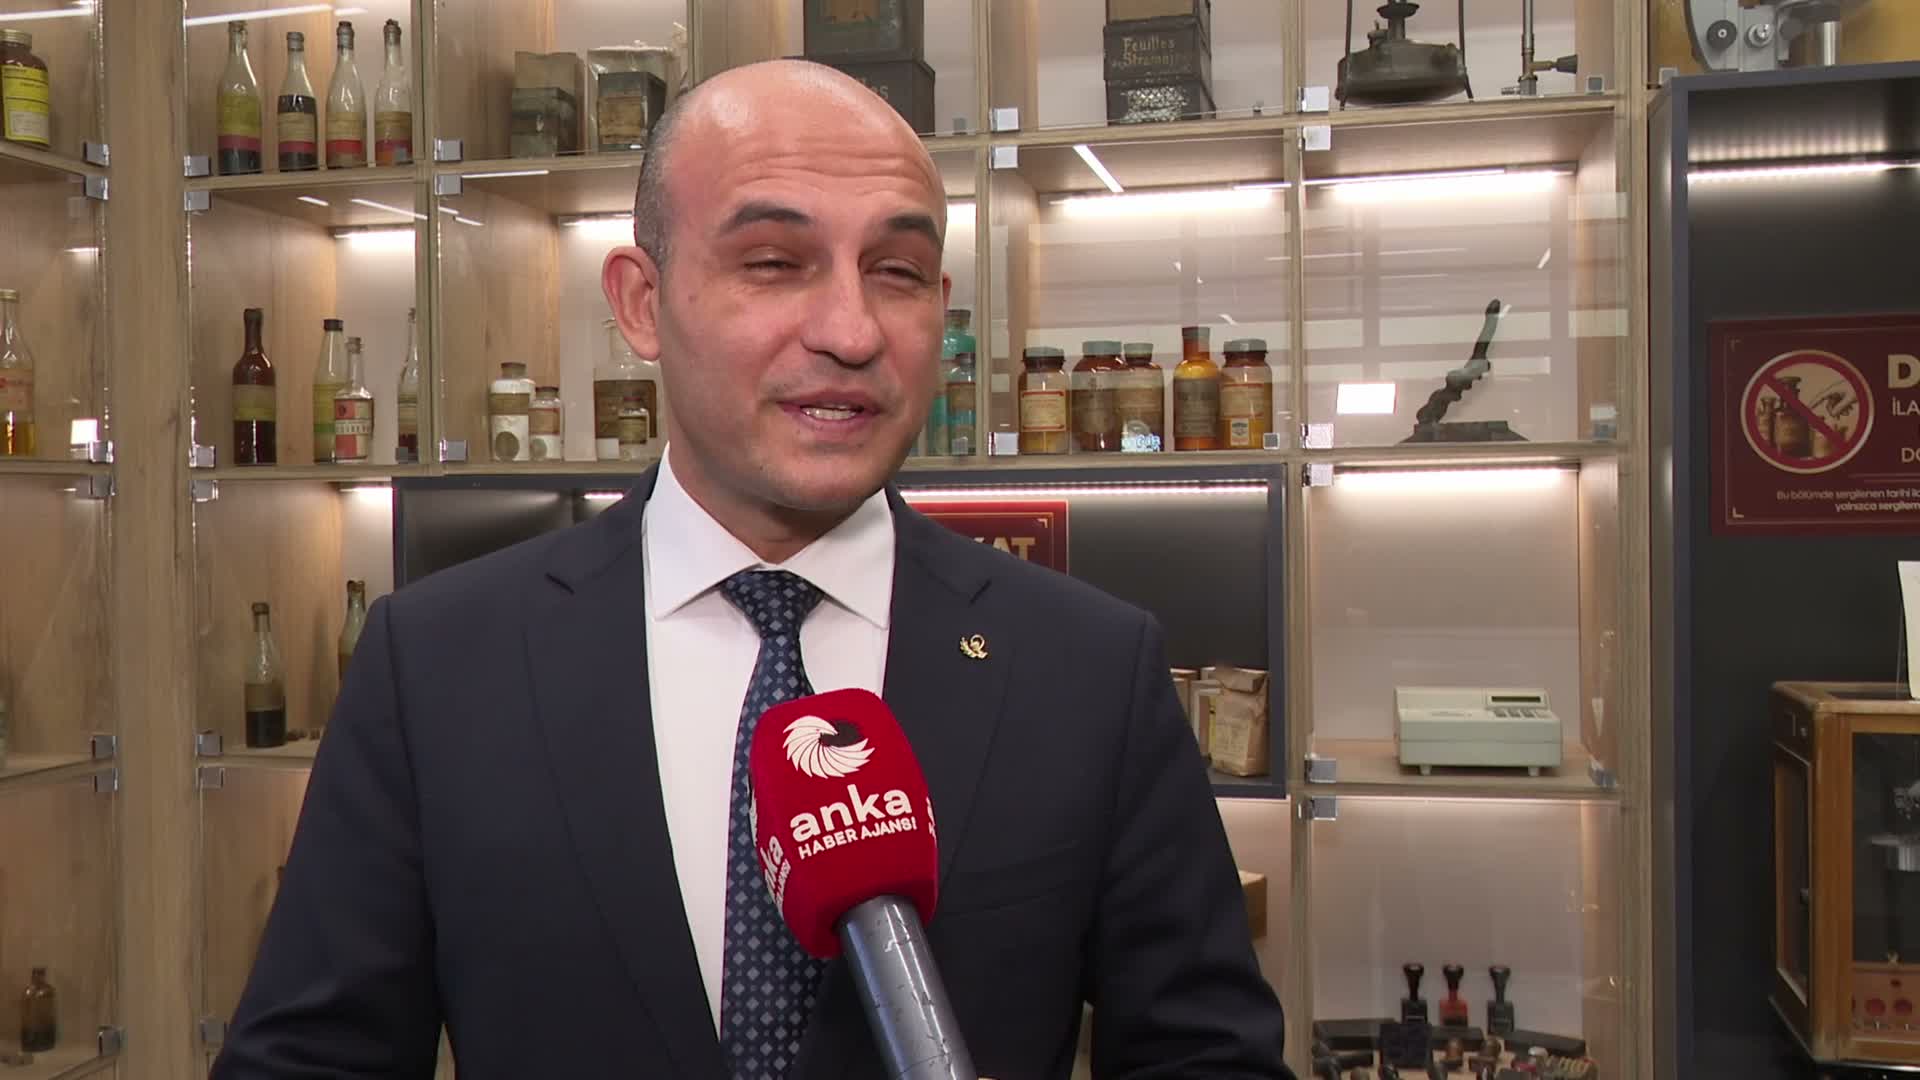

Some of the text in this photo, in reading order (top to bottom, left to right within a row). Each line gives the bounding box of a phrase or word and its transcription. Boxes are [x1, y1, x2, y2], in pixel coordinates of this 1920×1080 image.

[790, 784, 912, 842] anka
[798, 828, 858, 860] HABER
[861, 816, 917, 840] AJANSI
